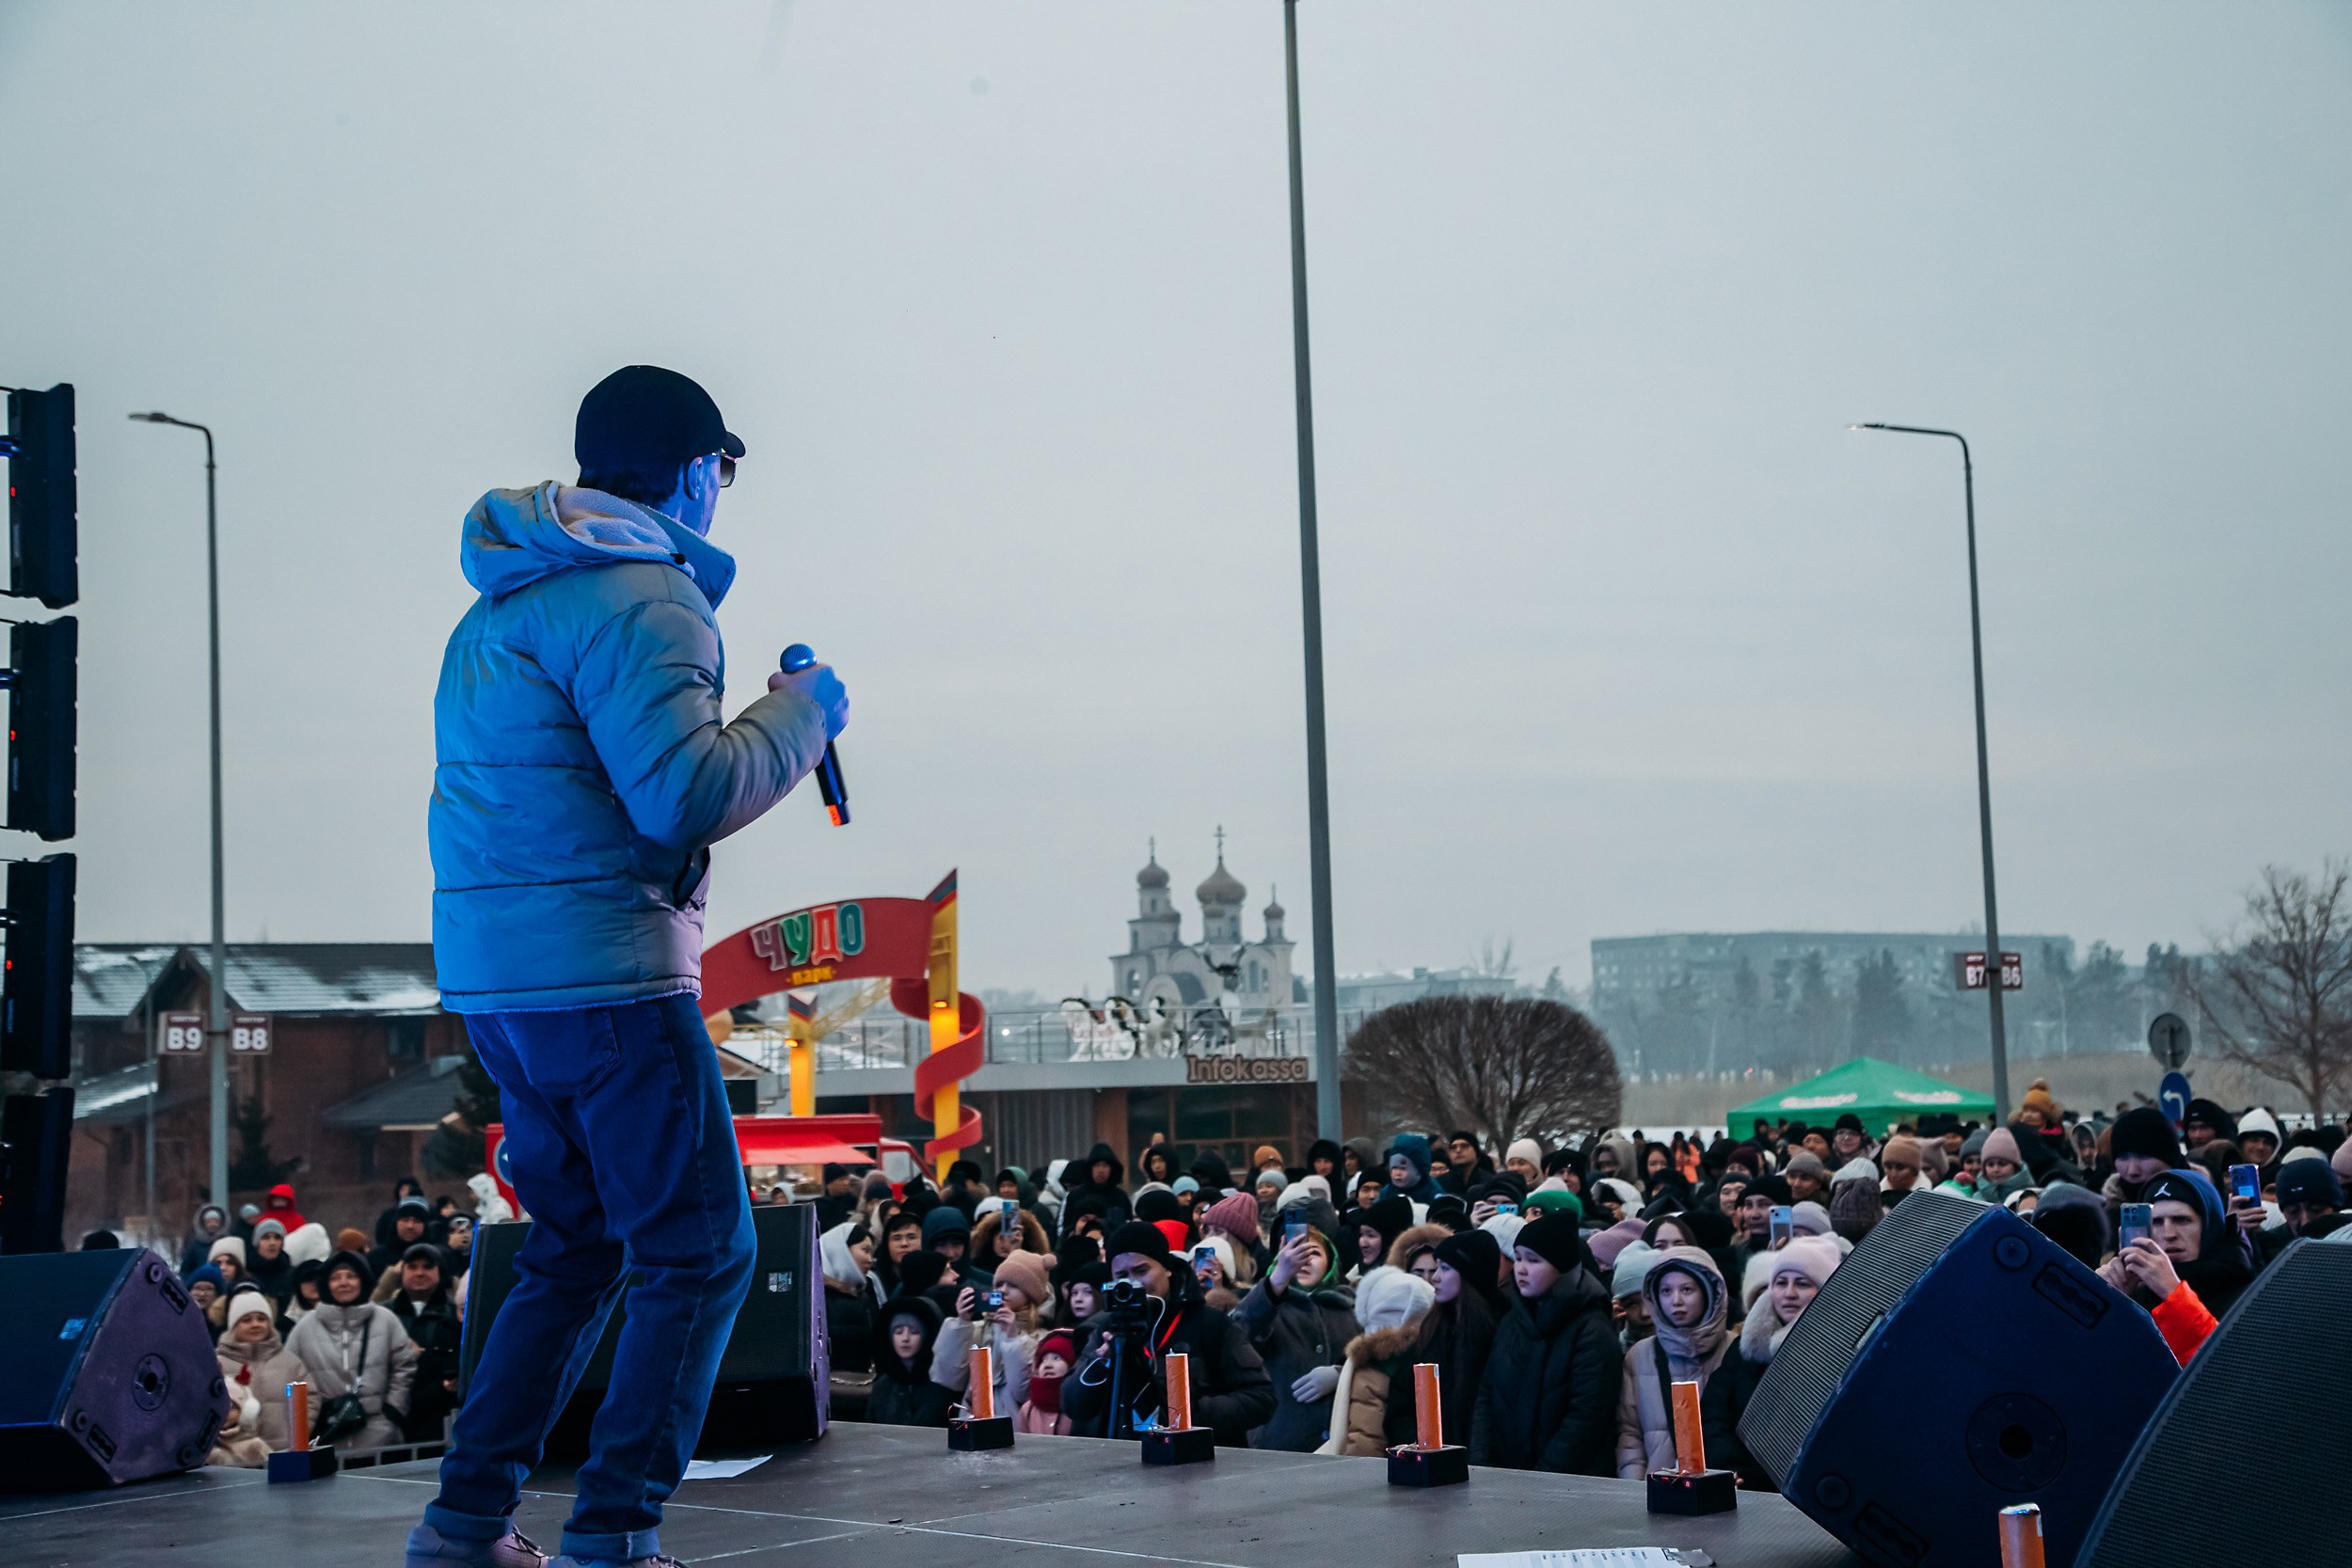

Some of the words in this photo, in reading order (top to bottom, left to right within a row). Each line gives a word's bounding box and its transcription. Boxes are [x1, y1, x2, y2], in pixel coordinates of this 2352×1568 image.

[750, 902, 865, 971] ЧУДО
[1966, 966, 1985, 986] B7
[167, 1027, 202, 1051] B9
[232, 1028, 268, 1051] B8
[1186, 1053, 1309, 1083] Infokassa
